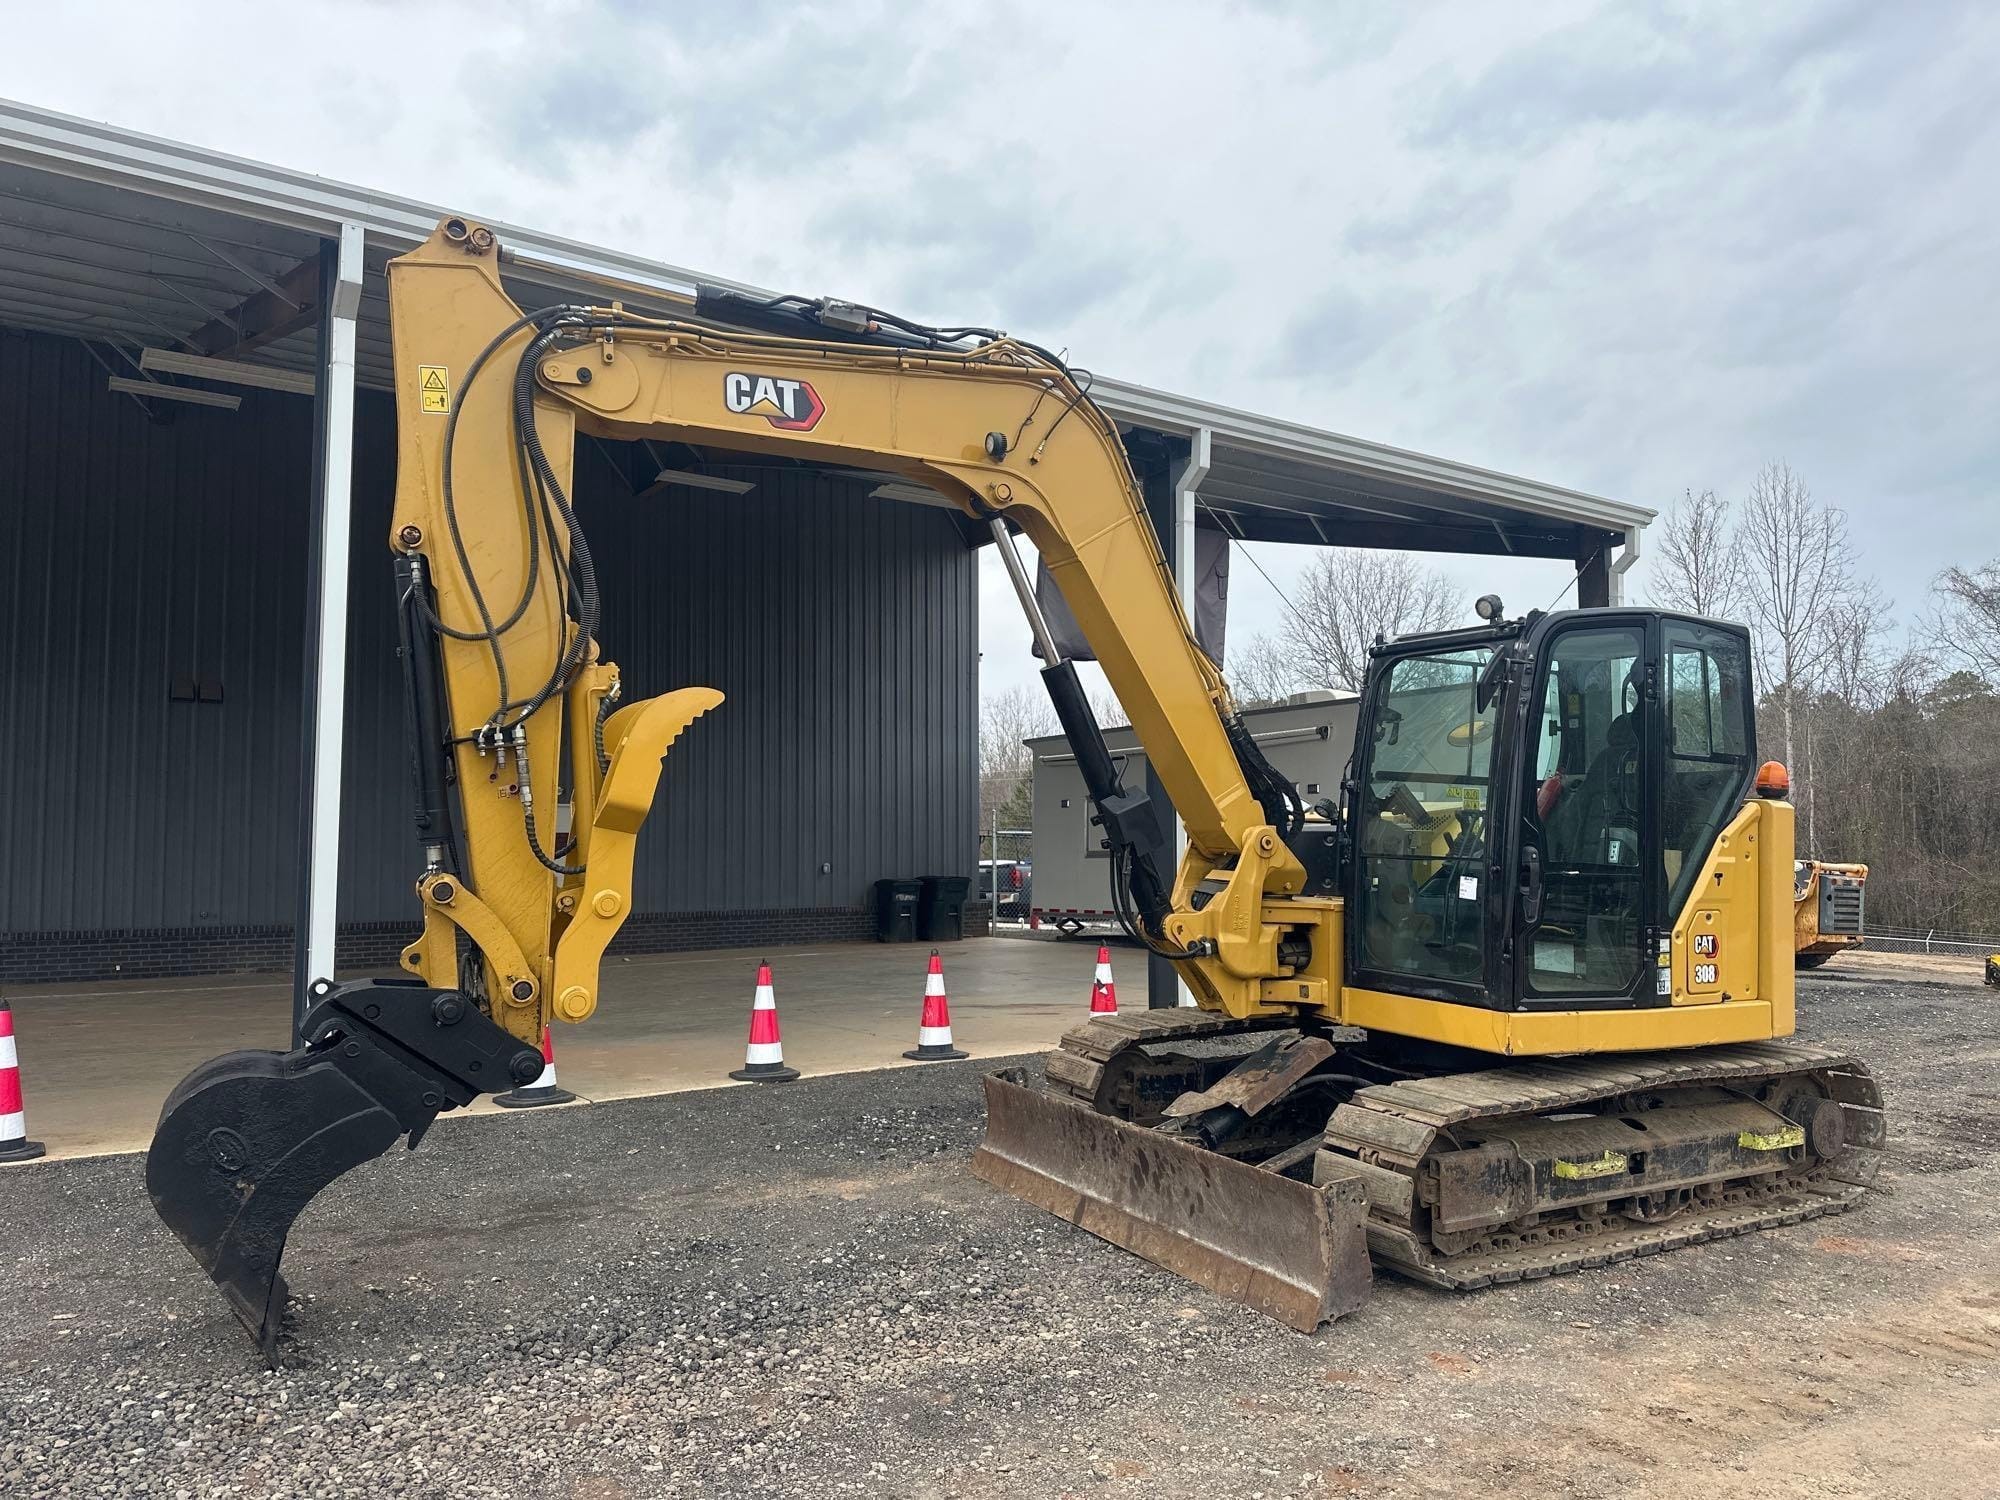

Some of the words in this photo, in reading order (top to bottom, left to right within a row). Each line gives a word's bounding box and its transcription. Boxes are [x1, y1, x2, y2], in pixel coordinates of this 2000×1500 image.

[726, 373, 800, 418] CAT
[1694, 935, 1714, 954] CAT
[1695, 964, 1715, 983] 308
